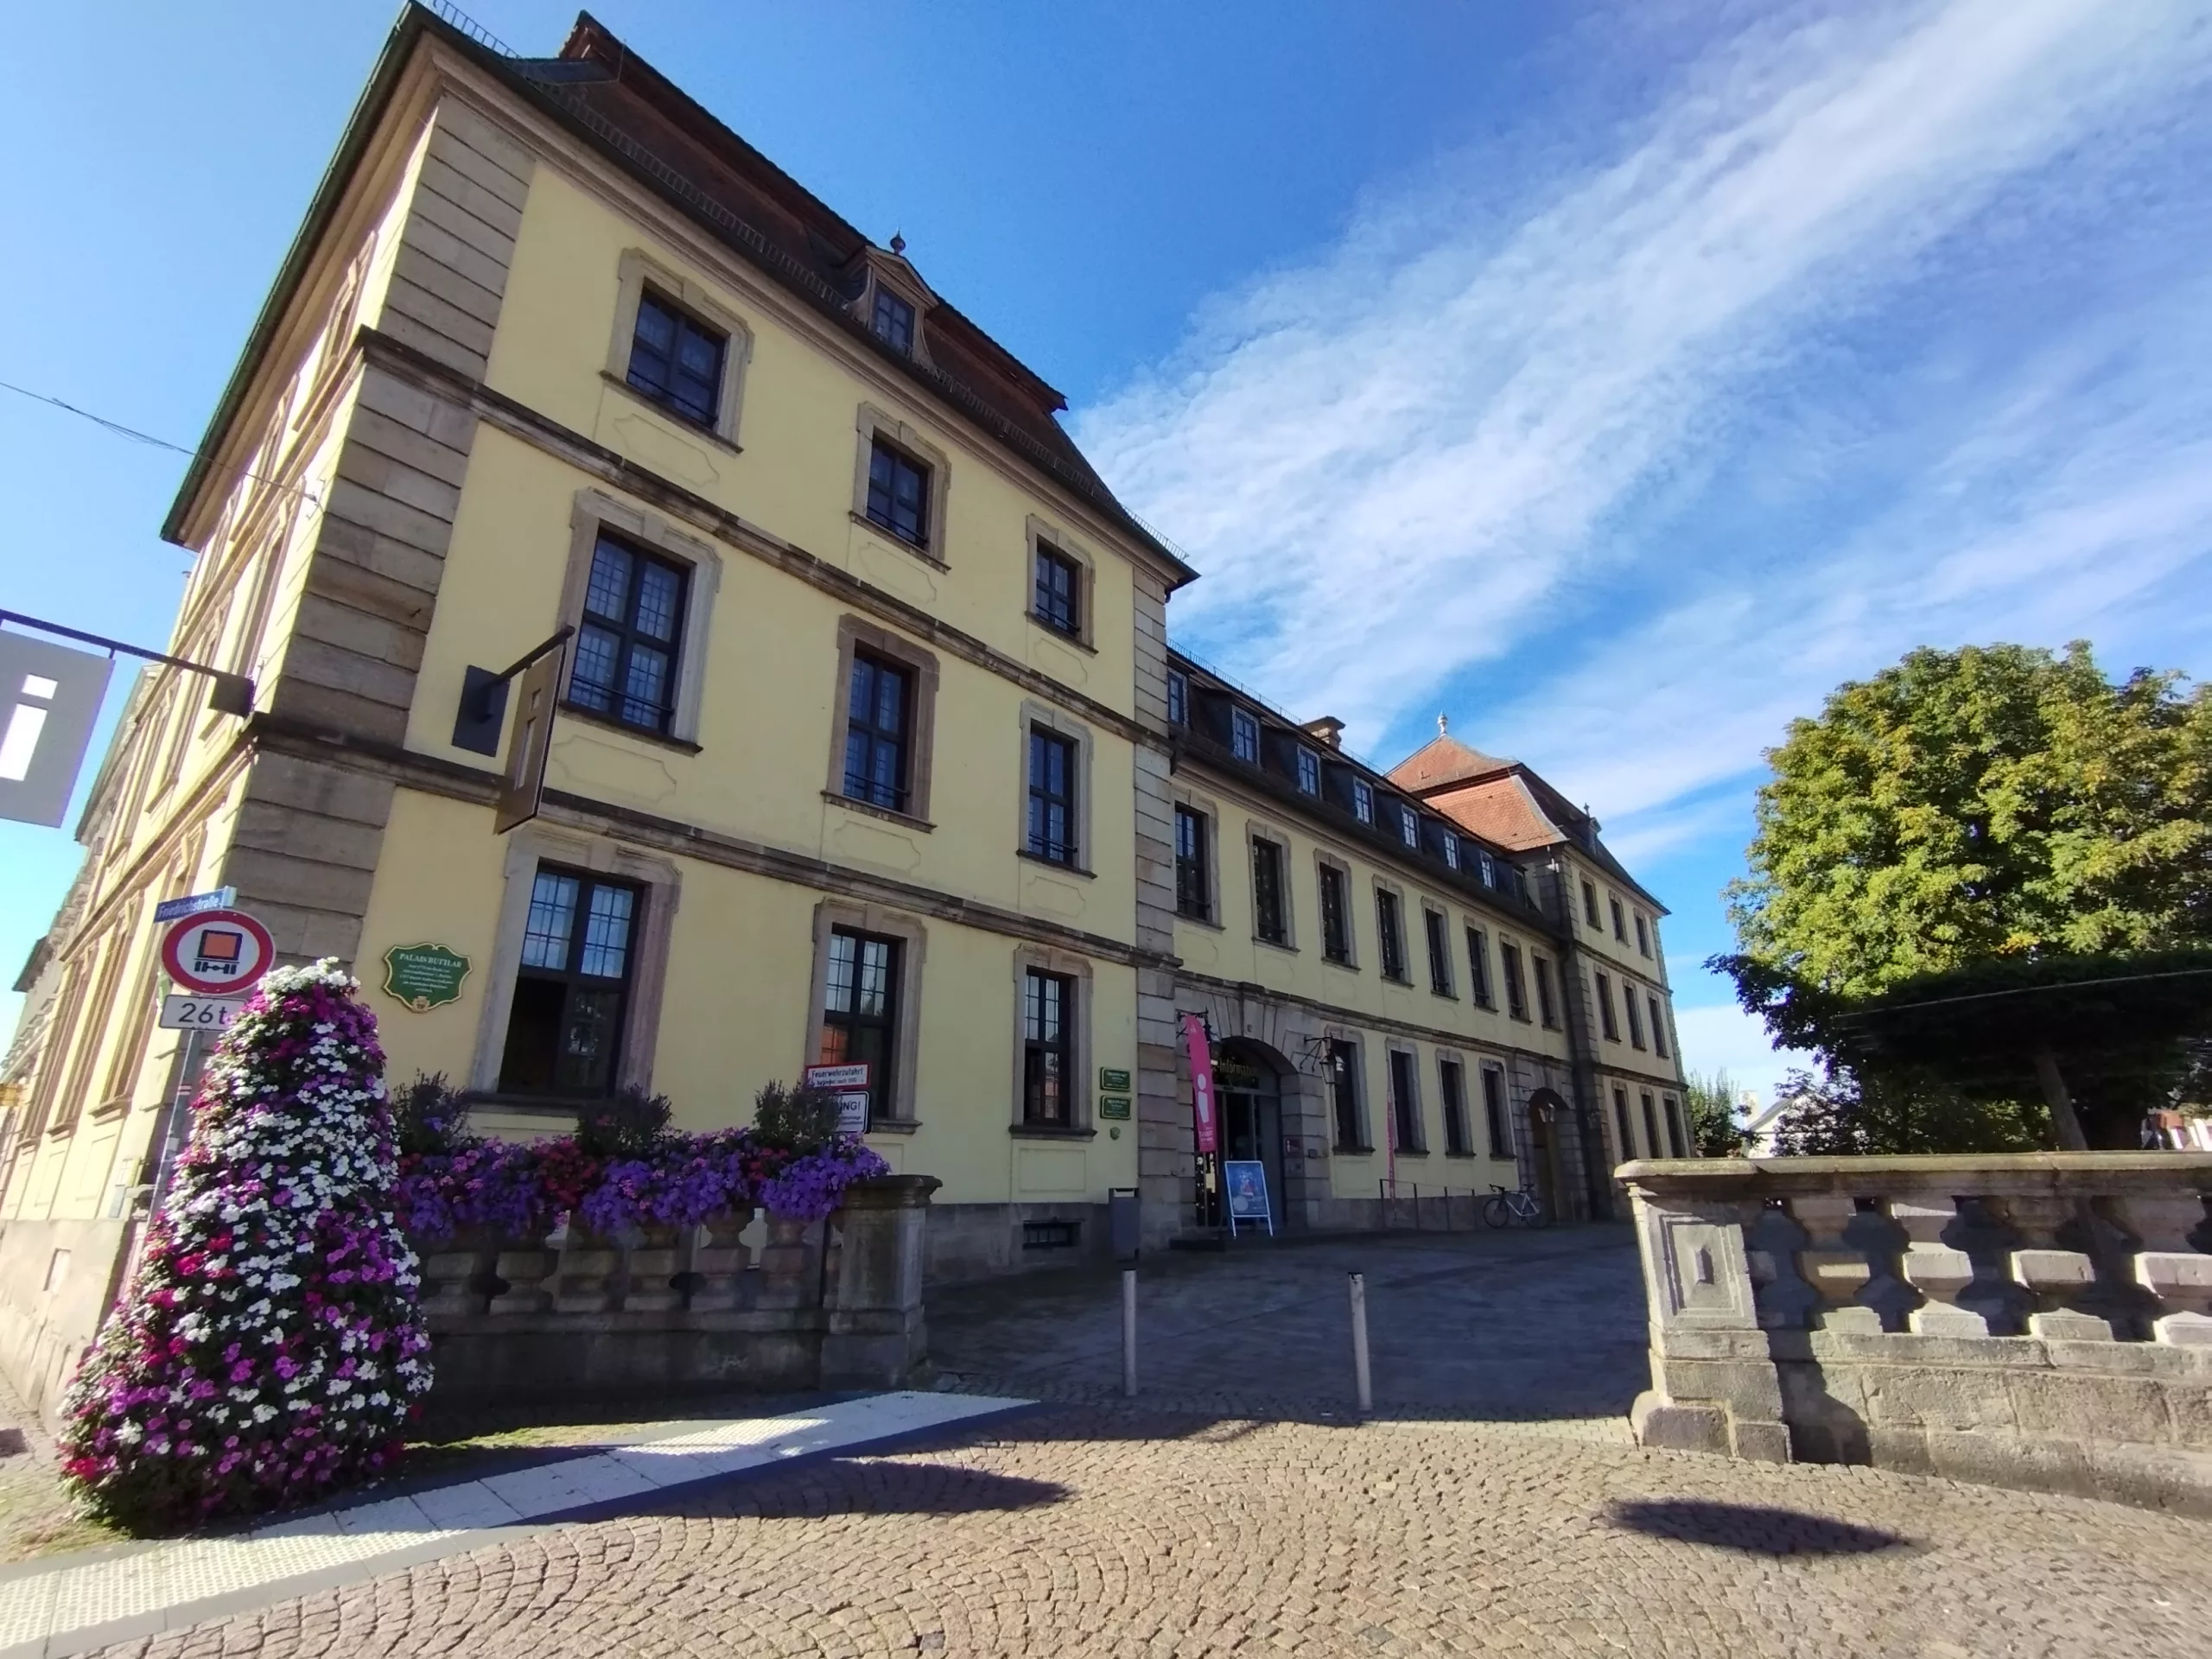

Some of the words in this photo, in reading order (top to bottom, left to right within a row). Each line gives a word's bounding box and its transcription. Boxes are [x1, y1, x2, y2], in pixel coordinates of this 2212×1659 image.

[399, 953, 428, 963] PALAIS
[428, 957, 462, 968] BUTTLAR
[812, 1067, 863, 1078] Feuerwehrzufahrt
